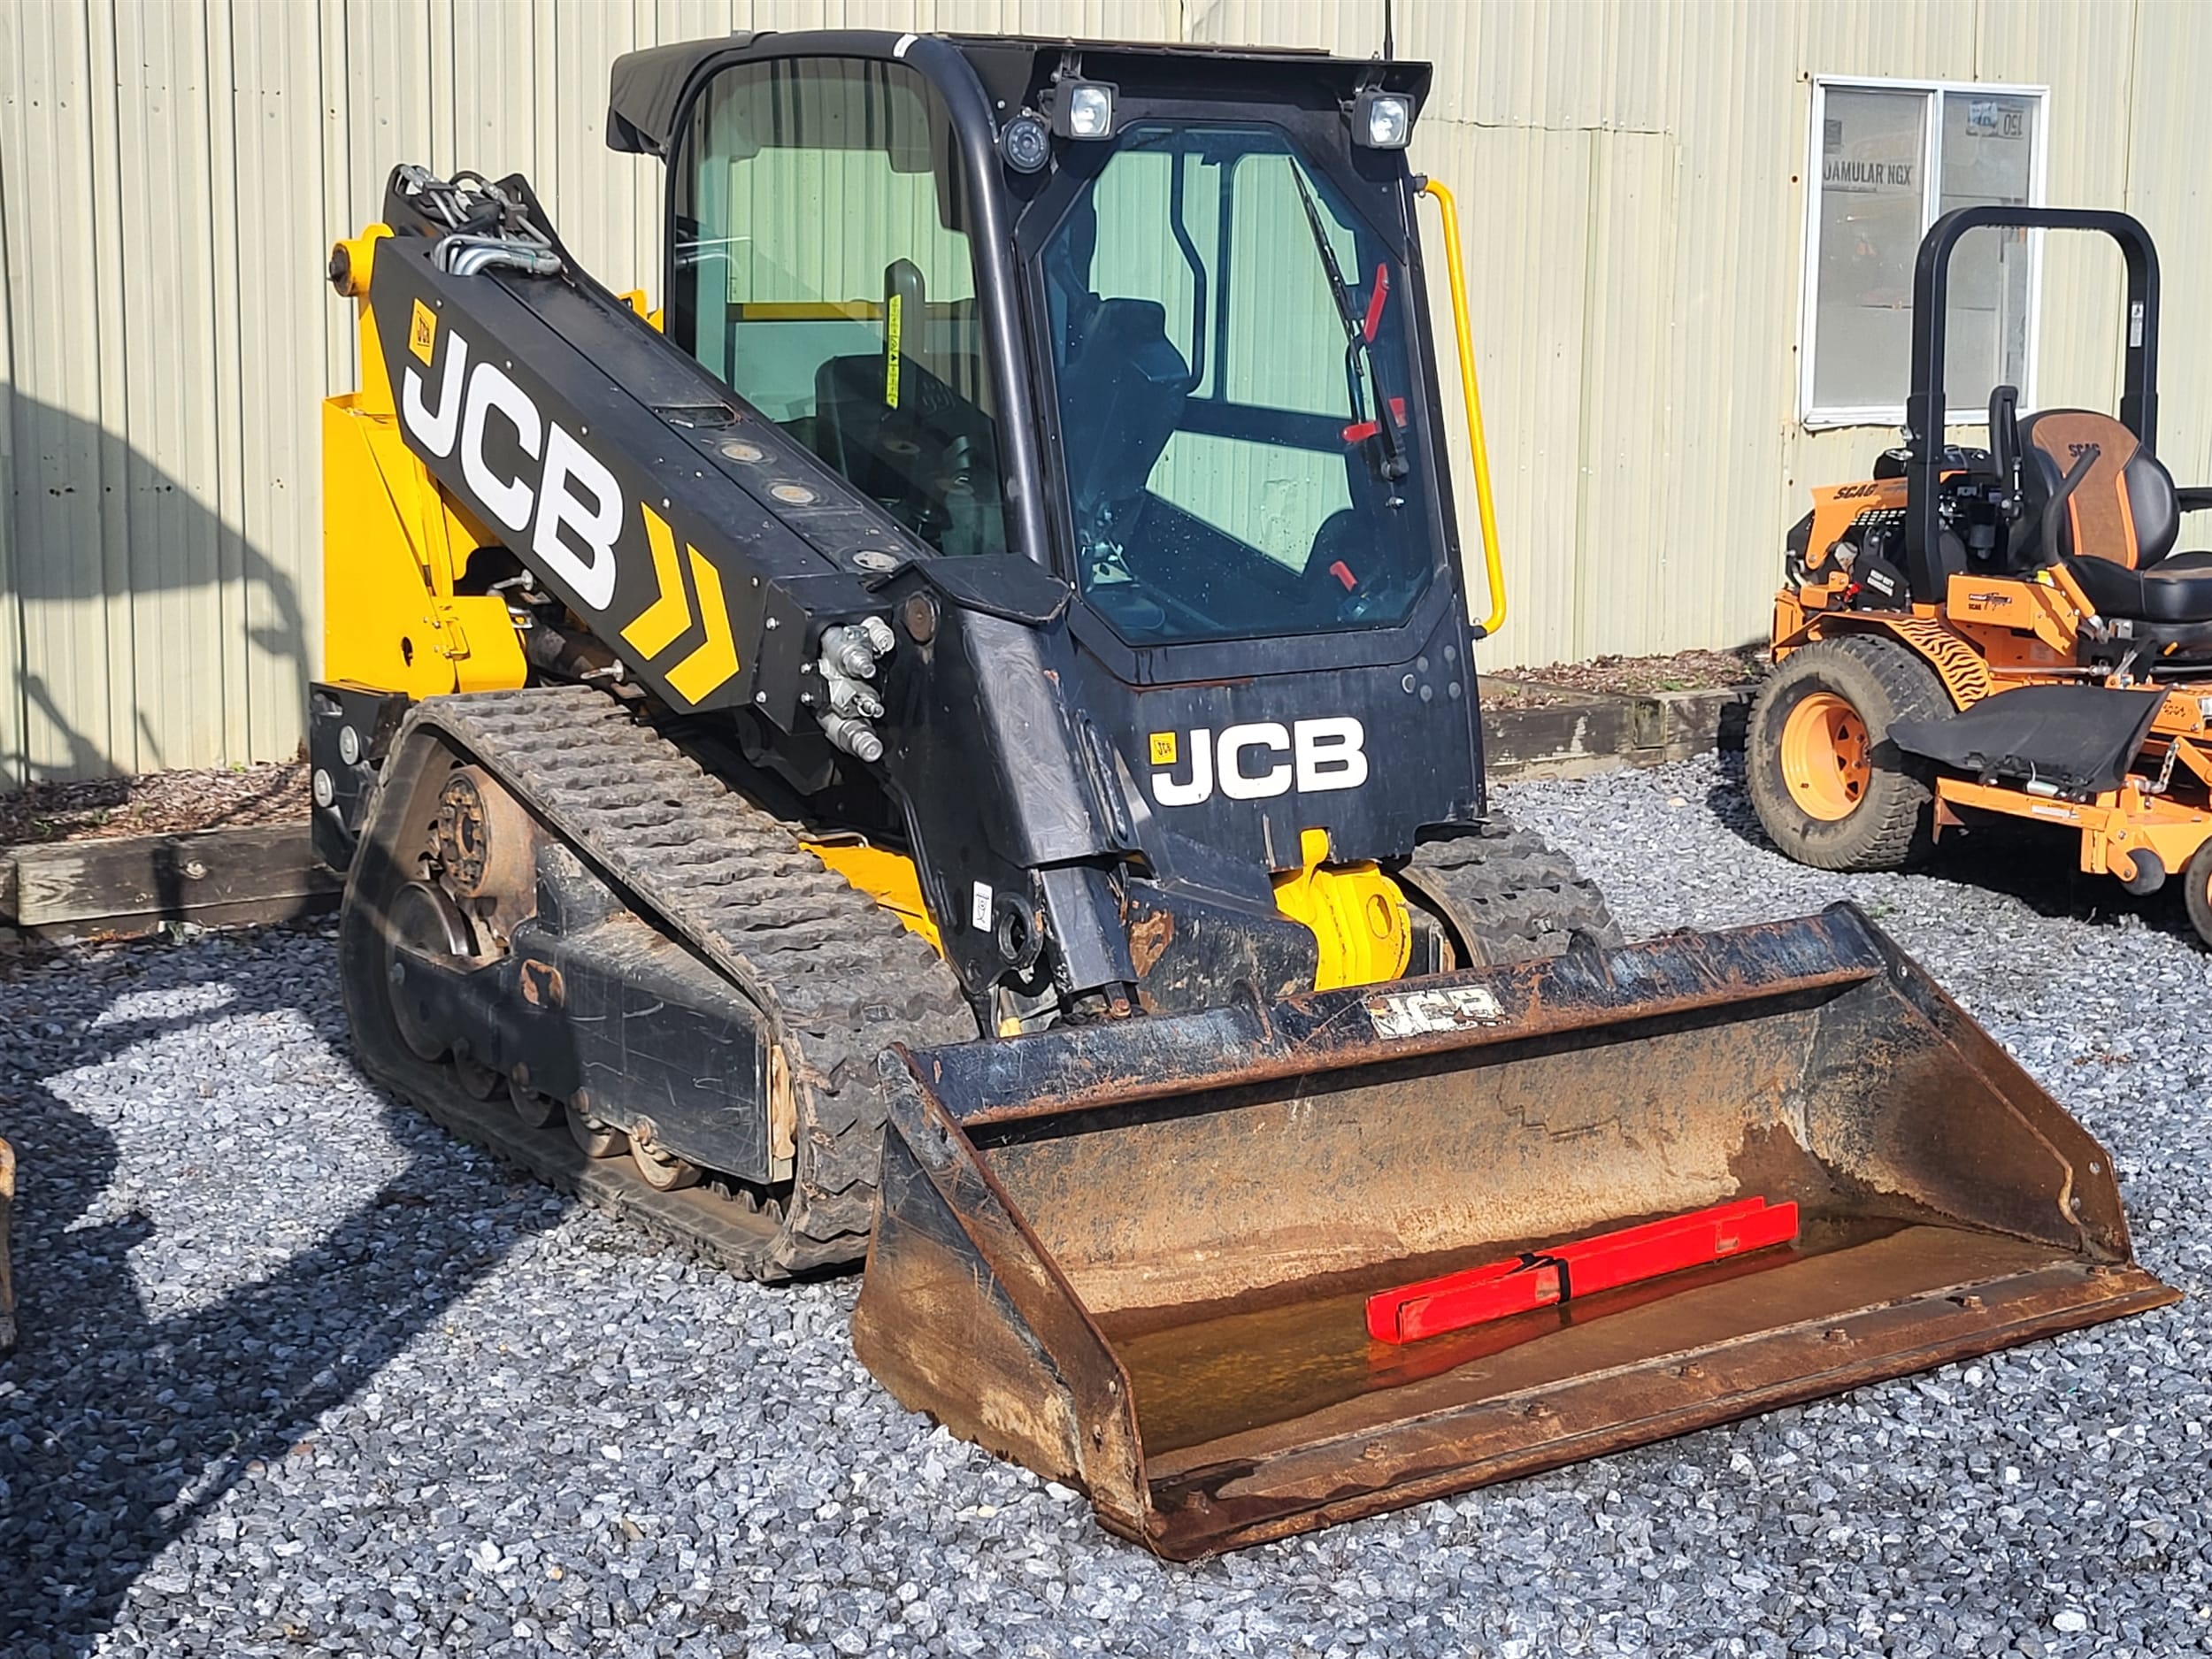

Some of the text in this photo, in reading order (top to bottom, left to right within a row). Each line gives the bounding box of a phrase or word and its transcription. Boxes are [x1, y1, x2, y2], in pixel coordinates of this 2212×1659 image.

[402, 329, 623, 611] JCB
[1833, 483, 1878, 500] SCAG
[1151, 717, 1369, 807] JCB
[1155, 740, 1172, 757] JCB
